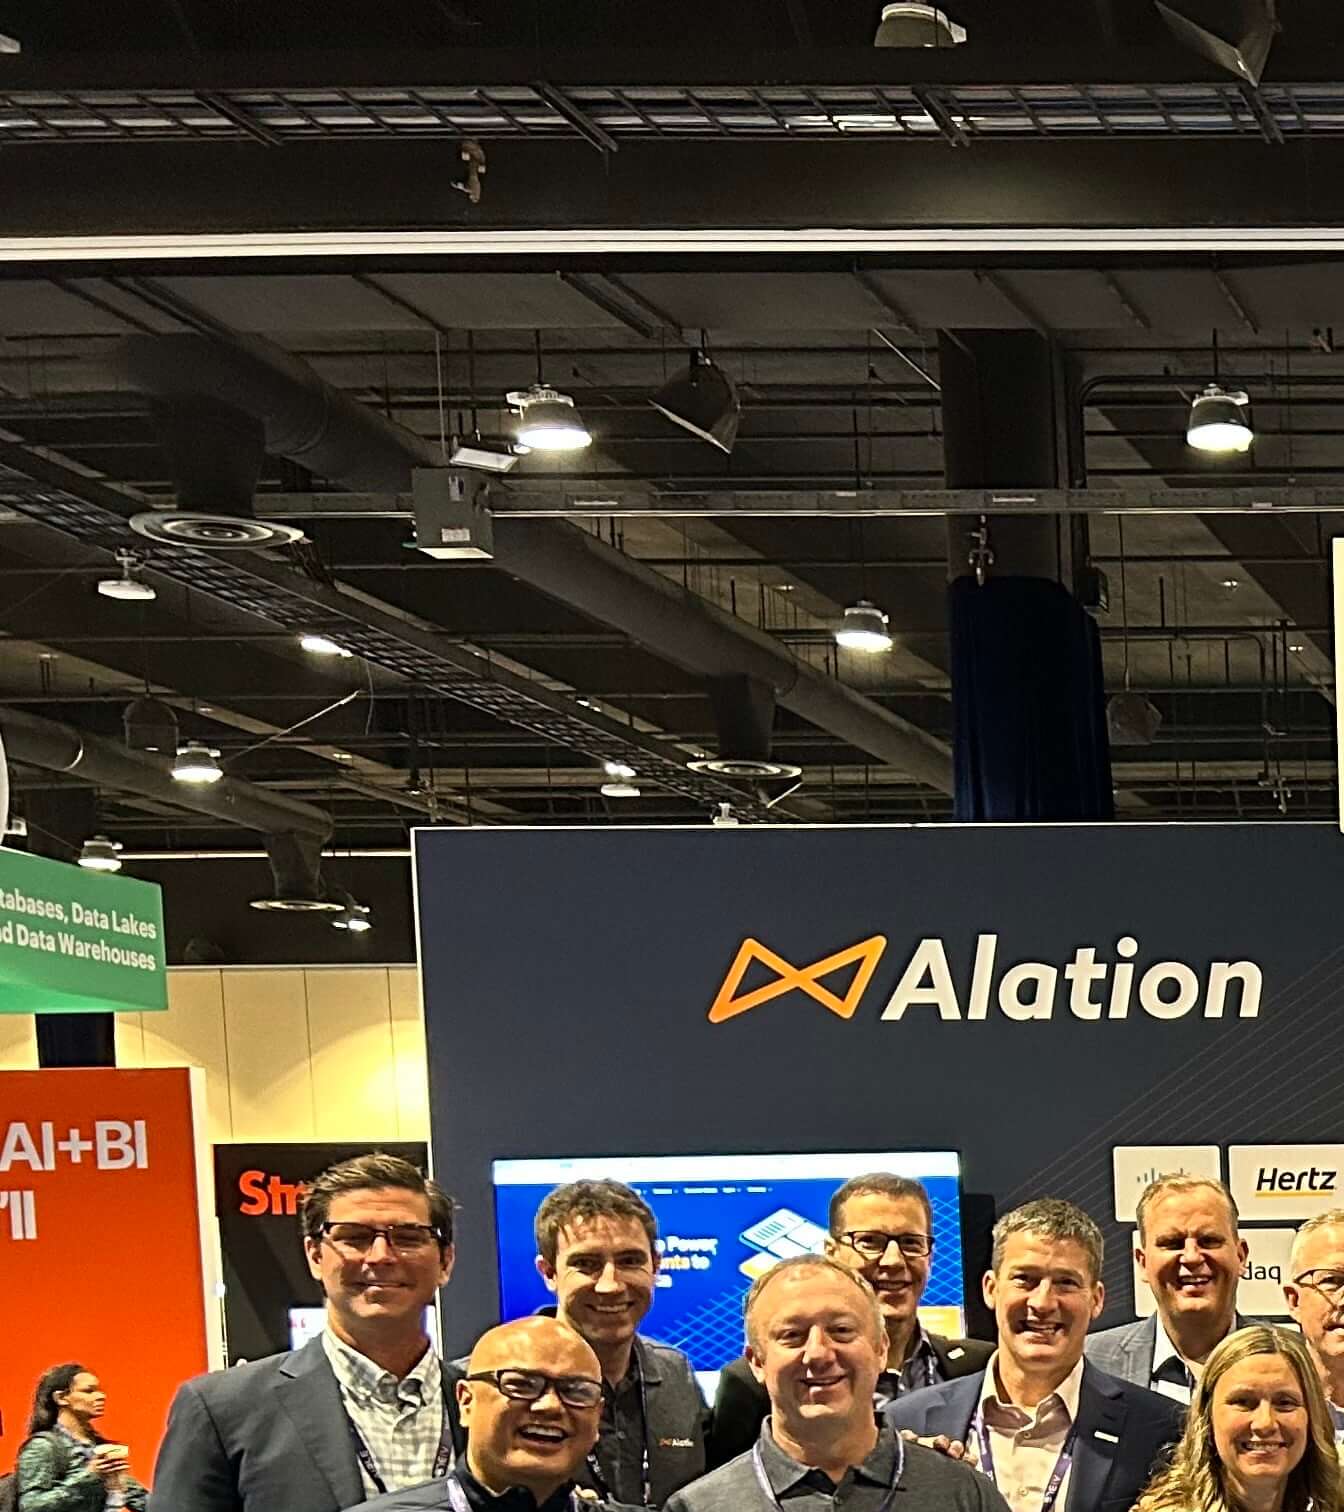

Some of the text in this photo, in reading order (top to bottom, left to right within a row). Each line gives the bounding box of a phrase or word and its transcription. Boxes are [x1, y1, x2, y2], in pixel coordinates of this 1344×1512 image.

[0, 921, 156, 971] d Data Warehouses
[72, 902, 109, 930] Data
[112, 910, 157, 940] Lakes
[880, 934, 1263, 1021] Alation
[0, 1120, 148, 1171] AI+BI
[1256, 1167, 1337, 1192] Hertz
